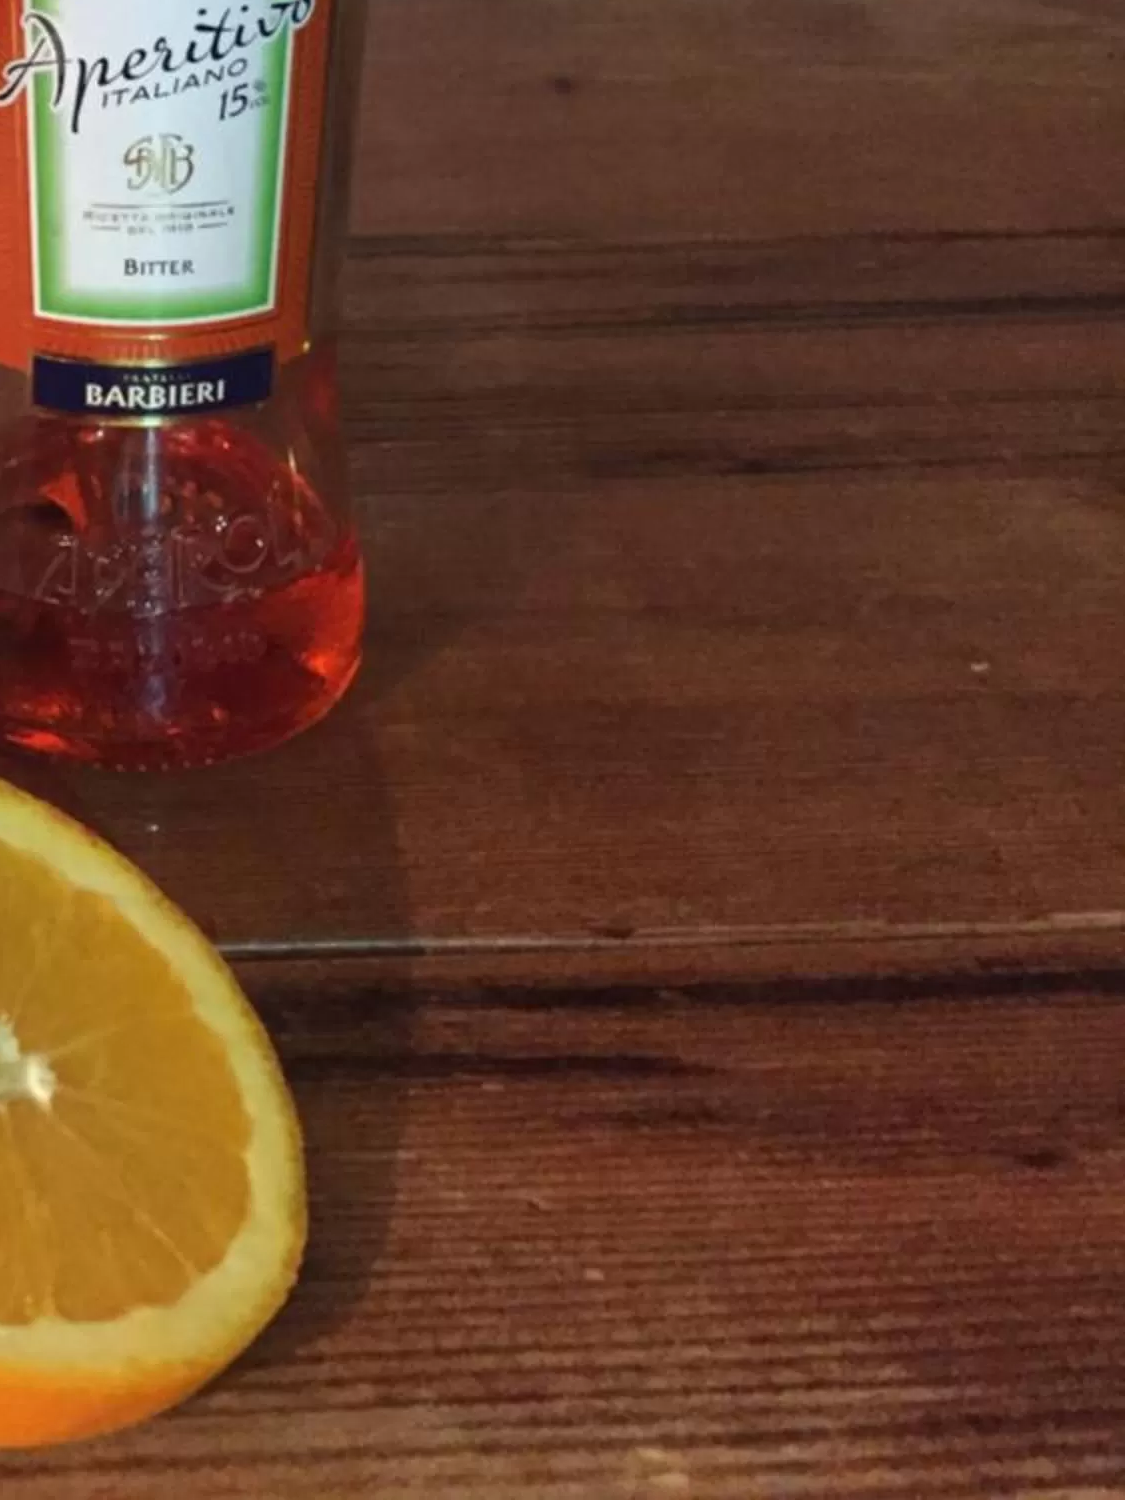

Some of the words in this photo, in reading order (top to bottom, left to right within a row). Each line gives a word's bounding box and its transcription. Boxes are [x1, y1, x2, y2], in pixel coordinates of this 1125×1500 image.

[101, 58, 248, 108] ITALIANO
[123, 257, 195, 277] BITTER
[85, 379, 225, 410] BARBIERI
